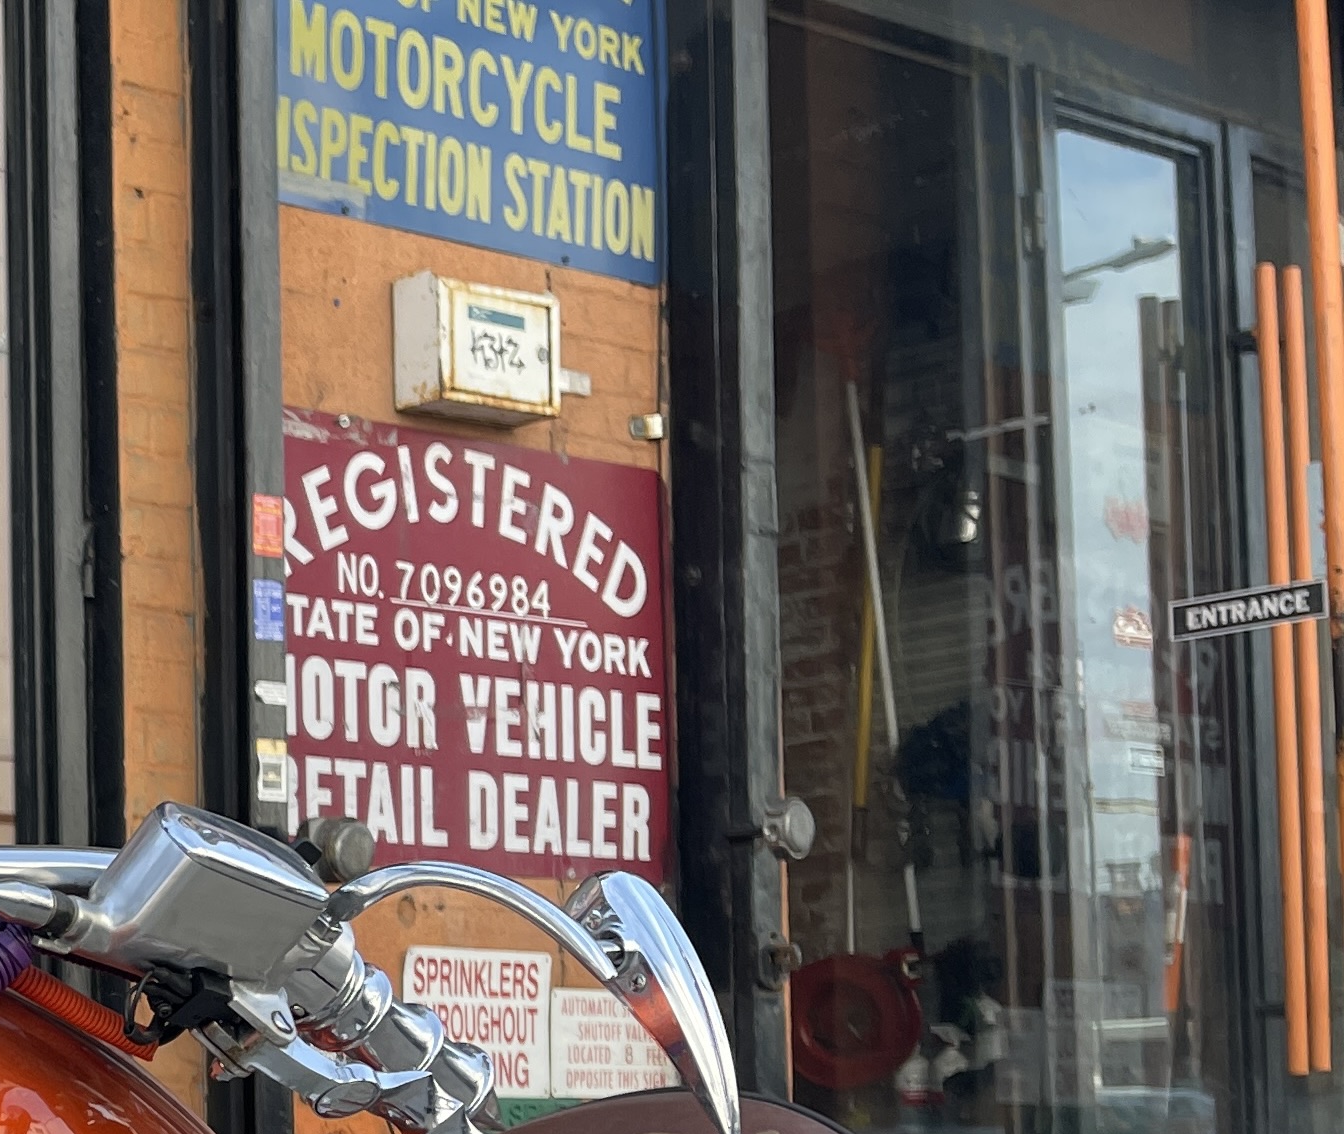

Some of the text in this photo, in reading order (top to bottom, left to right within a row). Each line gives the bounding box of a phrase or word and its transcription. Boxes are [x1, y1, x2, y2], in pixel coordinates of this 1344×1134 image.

[456, 0, 646, 76] NEW YORK
[289, 0, 622, 161] MOTORCYCLE
[503, 153, 656, 262] STATION
[337, 552, 551, 619] NO. 7096984
[1185, 588, 1311, 631] ENTRANCE
[286, 594, 379, 646] TATE
[394, 608, 446, 653] OF
[459, 616, 542, 665] NEW
[554, 627, 653, 679] YORK
[460, 672, 662, 771] VEHICLE
[468, 769, 652, 863] DEALER
[413, 956, 539, 1000] SPRINKLERS
[432, 1002, 539, 1045] ROUGHOUT
[561, 996, 619, 1018] AUTOMATIC
[578, 1021, 623, 1042] SHUTOFF
[565, 1069, 614, 1090] OPPOSITE
[617, 1071, 640, 1091] THIS
[567, 1044, 612, 1066] LOCATED
[624, 1044, 634, 1066] 8
